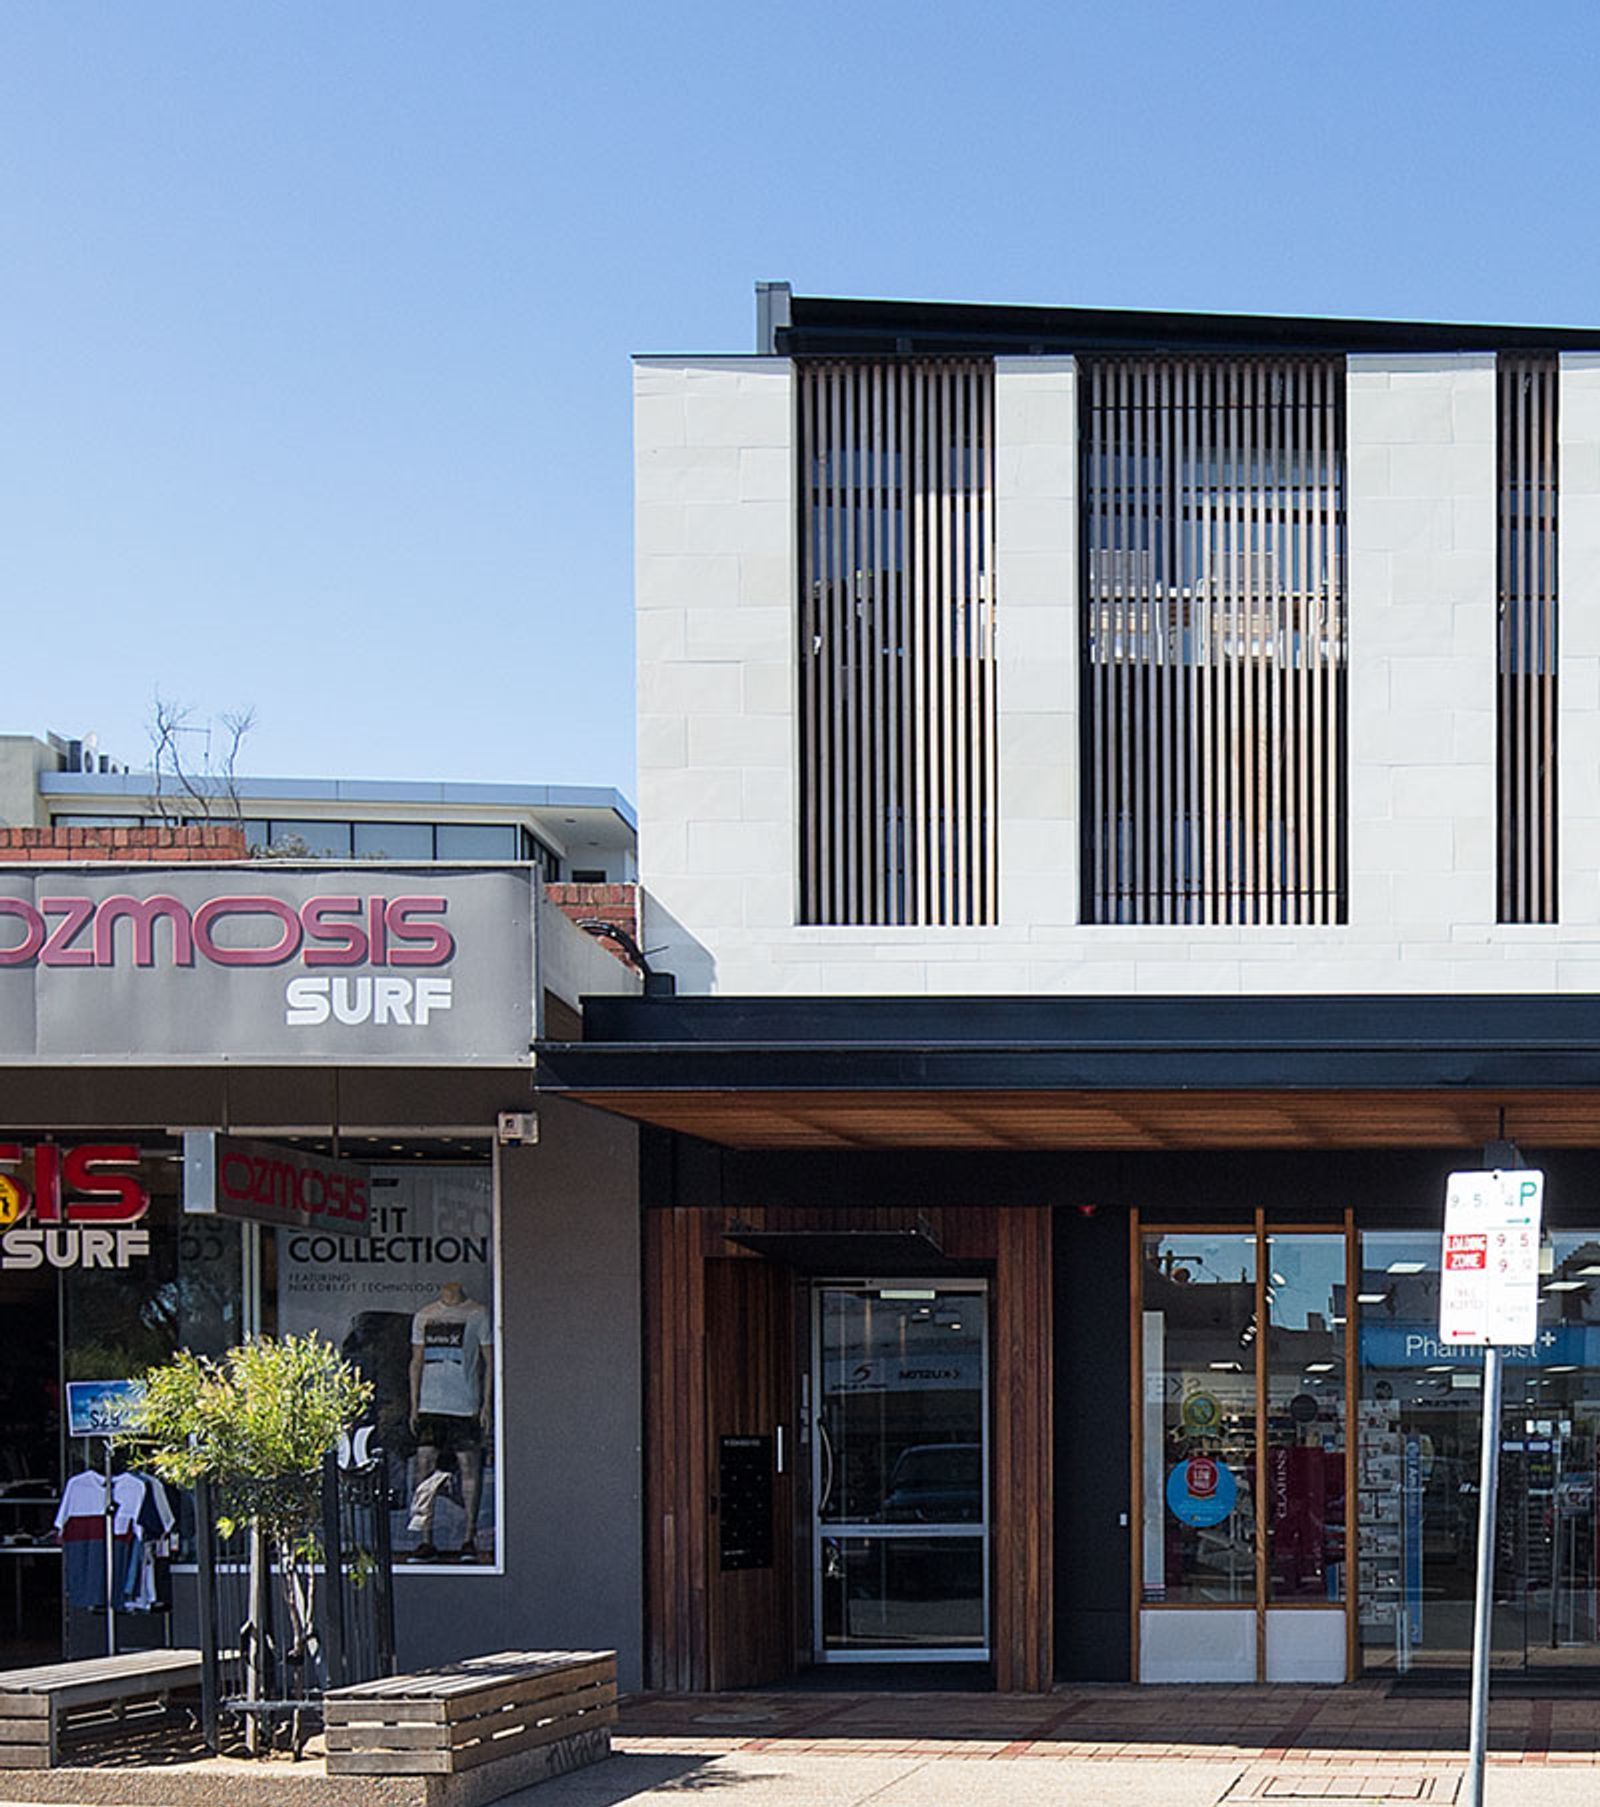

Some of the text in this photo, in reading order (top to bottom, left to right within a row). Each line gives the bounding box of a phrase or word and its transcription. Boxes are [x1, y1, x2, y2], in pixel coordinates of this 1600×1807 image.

[285, 977, 452, 1026] SURF
[220, 1152, 369, 1223] OZMOSIS
[1520, 1181, 1537, 1207] P
[2, 1230, 150, 1269] SURF
[288, 1236, 487, 1263] COLLECTION
